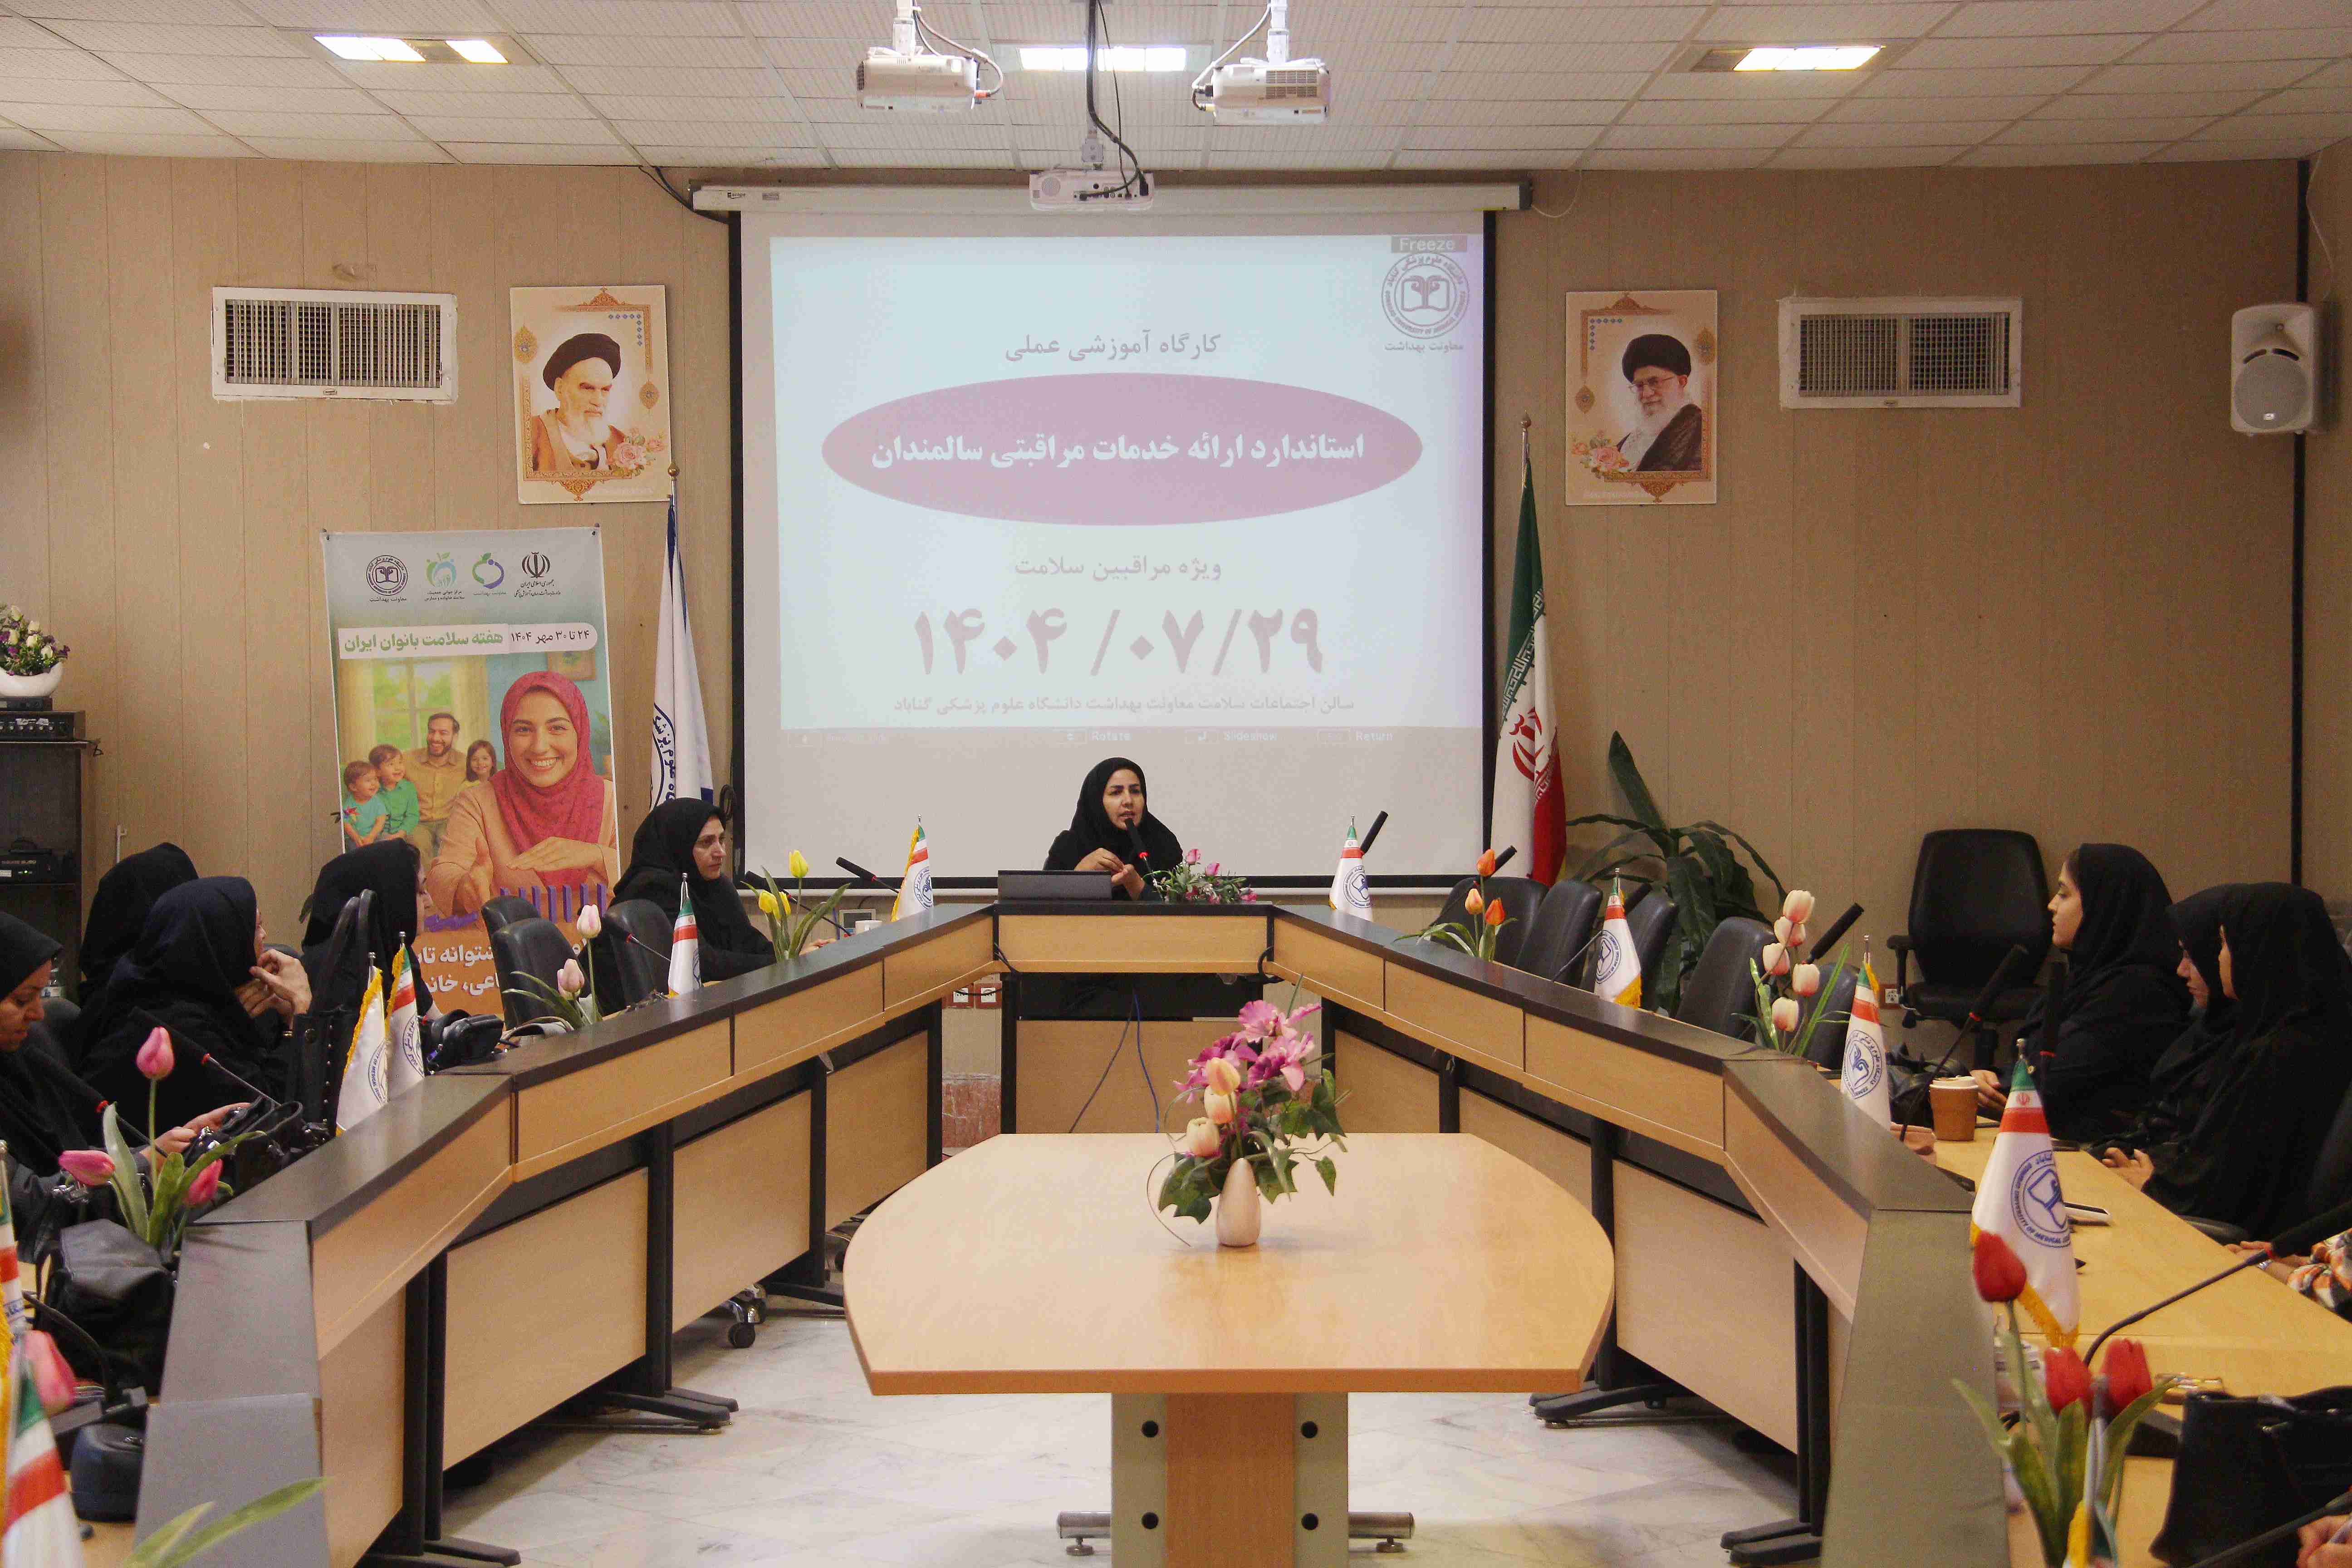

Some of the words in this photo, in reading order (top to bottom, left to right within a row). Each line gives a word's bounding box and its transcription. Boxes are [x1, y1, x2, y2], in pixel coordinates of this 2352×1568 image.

[1401, 238, 1454, 250] Freeze
[1005, 334, 1060, 361] عملی
[1068, 329, 1151, 361] آموزشی
[1160, 333, 1221, 359] کارگاه
[1384, 341, 1426, 353] بهداشت
[871, 435, 982, 468] سالمندان
[991, 435, 1085, 468] مراقبتی
[1092, 434, 1180, 460] خدمات
[1187, 431, 1243, 467] ارائه
[1250, 434, 1364, 467] استاندارد
[1014, 556, 1084, 574] سلامت
[1092, 555, 1171, 581] مراقبین
[1180, 557, 1221, 581] ویژه
[344, 634, 376, 652] ایران
[380, 633, 419, 651] بانوان
[422, 631, 468, 646] سلامت
[472, 630, 503, 644] هفته
[511, 632, 531, 642] ۱۴۰۴
[536, 635, 553, 645] مهر
[556, 632, 566, 641] ۳۰
[569, 631, 576, 640] تا
[578, 630, 589, 640] ۲۴
[894, 699, 932, 712] گناباد
[937, 699, 986, 715] پزشکی
[991, 699, 1024, 715] علوم
[1028, 699, 1082, 712] دانشگاه
[1086, 699, 1142, 715] بهداشت
[1146, 697, 1194, 715] معاونت
[1198, 698, 1245, 711] سلامت
[1250, 698, 1316, 713] اجتماعات
[1320, 697, 1354, 715] سالن
